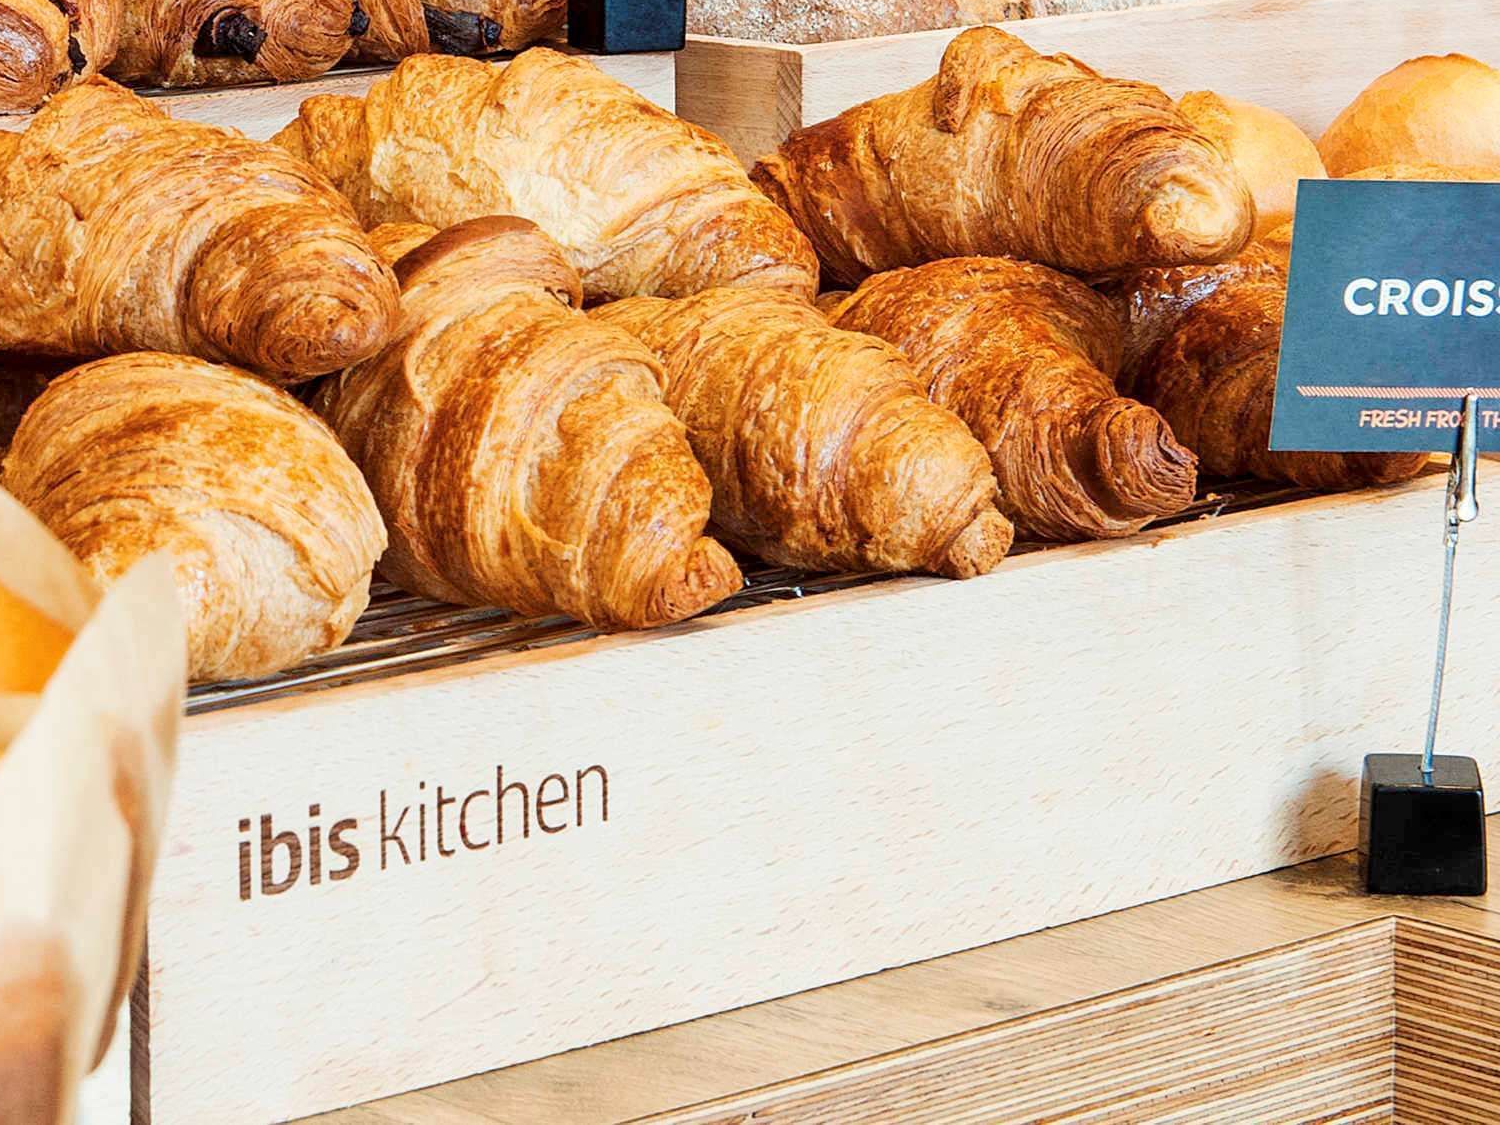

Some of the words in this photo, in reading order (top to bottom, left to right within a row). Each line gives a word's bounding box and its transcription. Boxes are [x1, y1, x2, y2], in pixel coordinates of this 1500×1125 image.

[1343, 278, 1500, 317] CROIS
[1359, 409, 1422, 429] FRESH
[1425, 409, 1467, 429] FRO
[238, 803, 360, 901] ibis
[380, 764, 609, 871] kitchen
